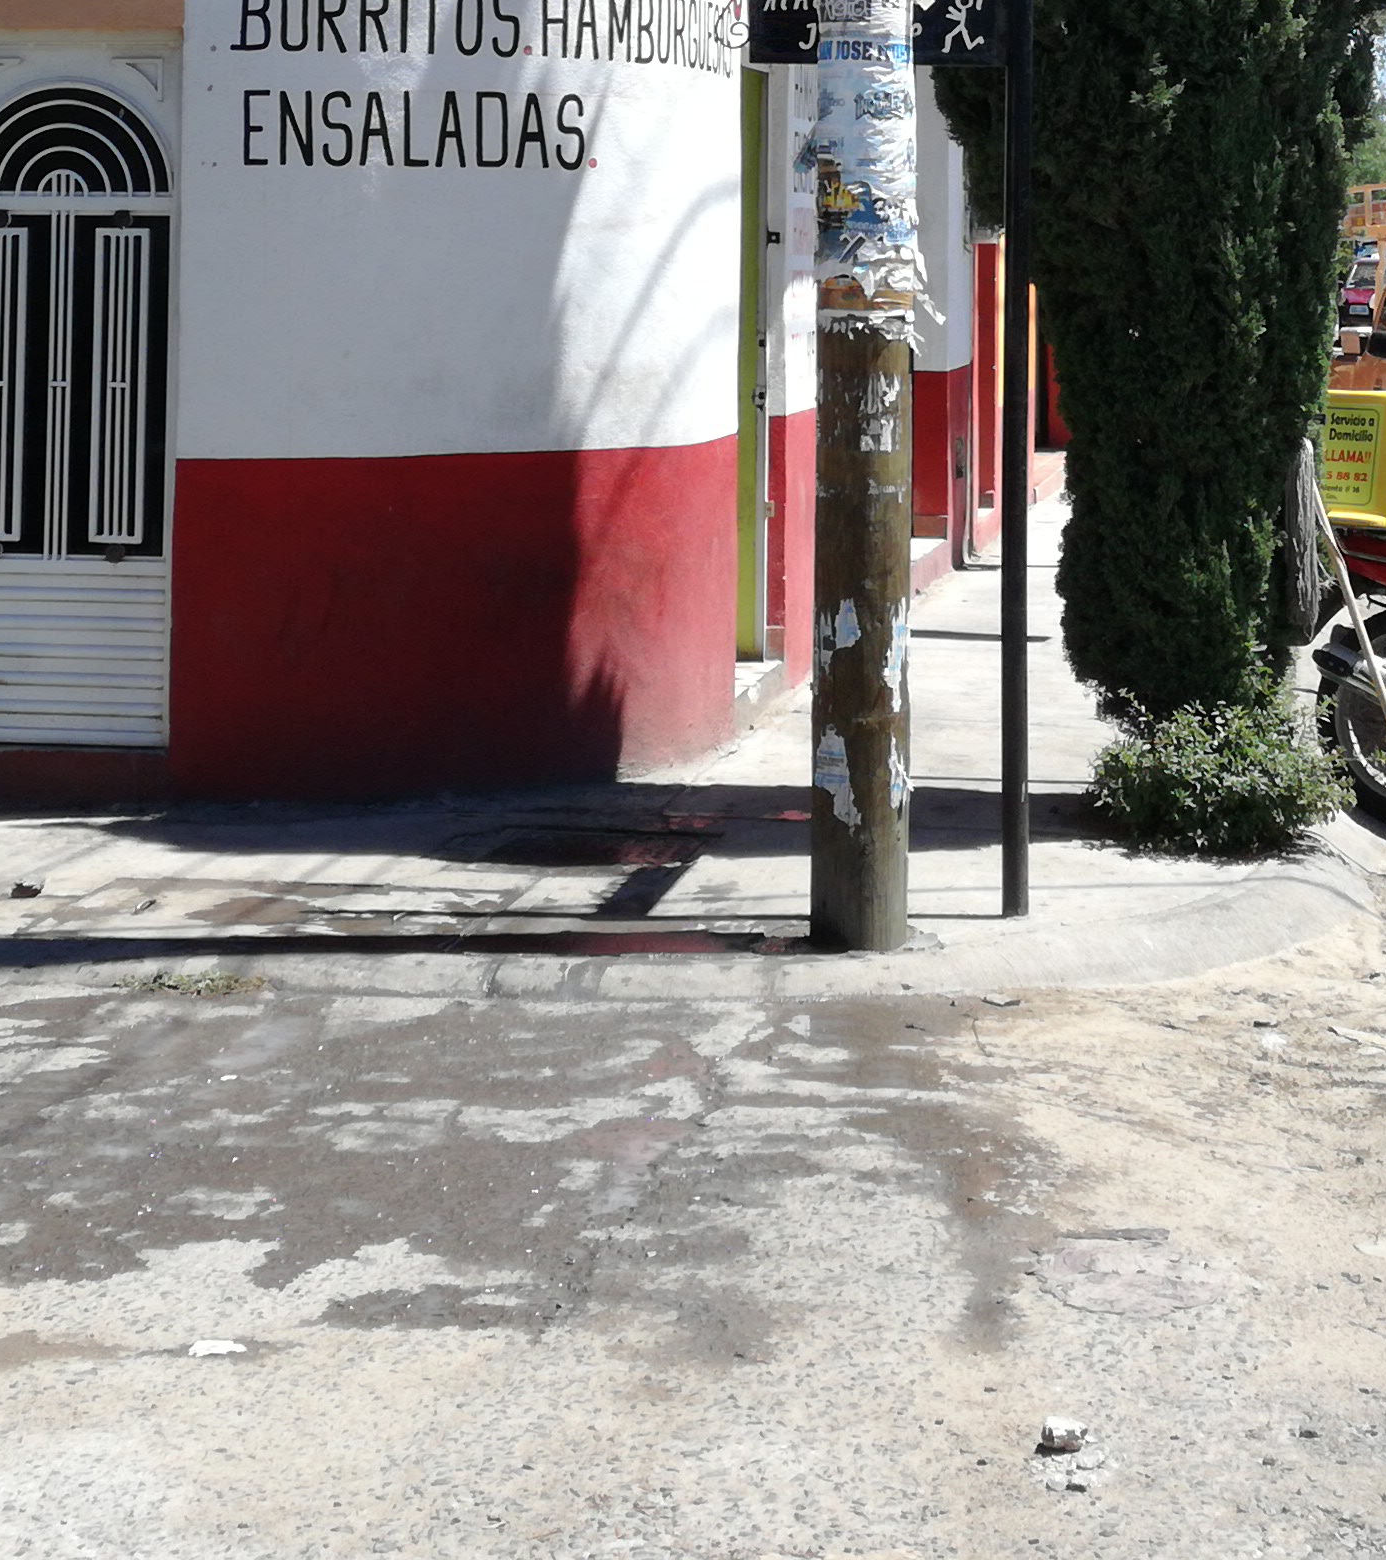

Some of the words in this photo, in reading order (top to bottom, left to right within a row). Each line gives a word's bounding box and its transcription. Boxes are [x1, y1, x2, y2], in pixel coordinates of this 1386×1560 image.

[1330, 412, 1367, 427] Servicio
[1368, 417, 1375, 427] a
[1329, 427, 1373, 442] Domicilio
